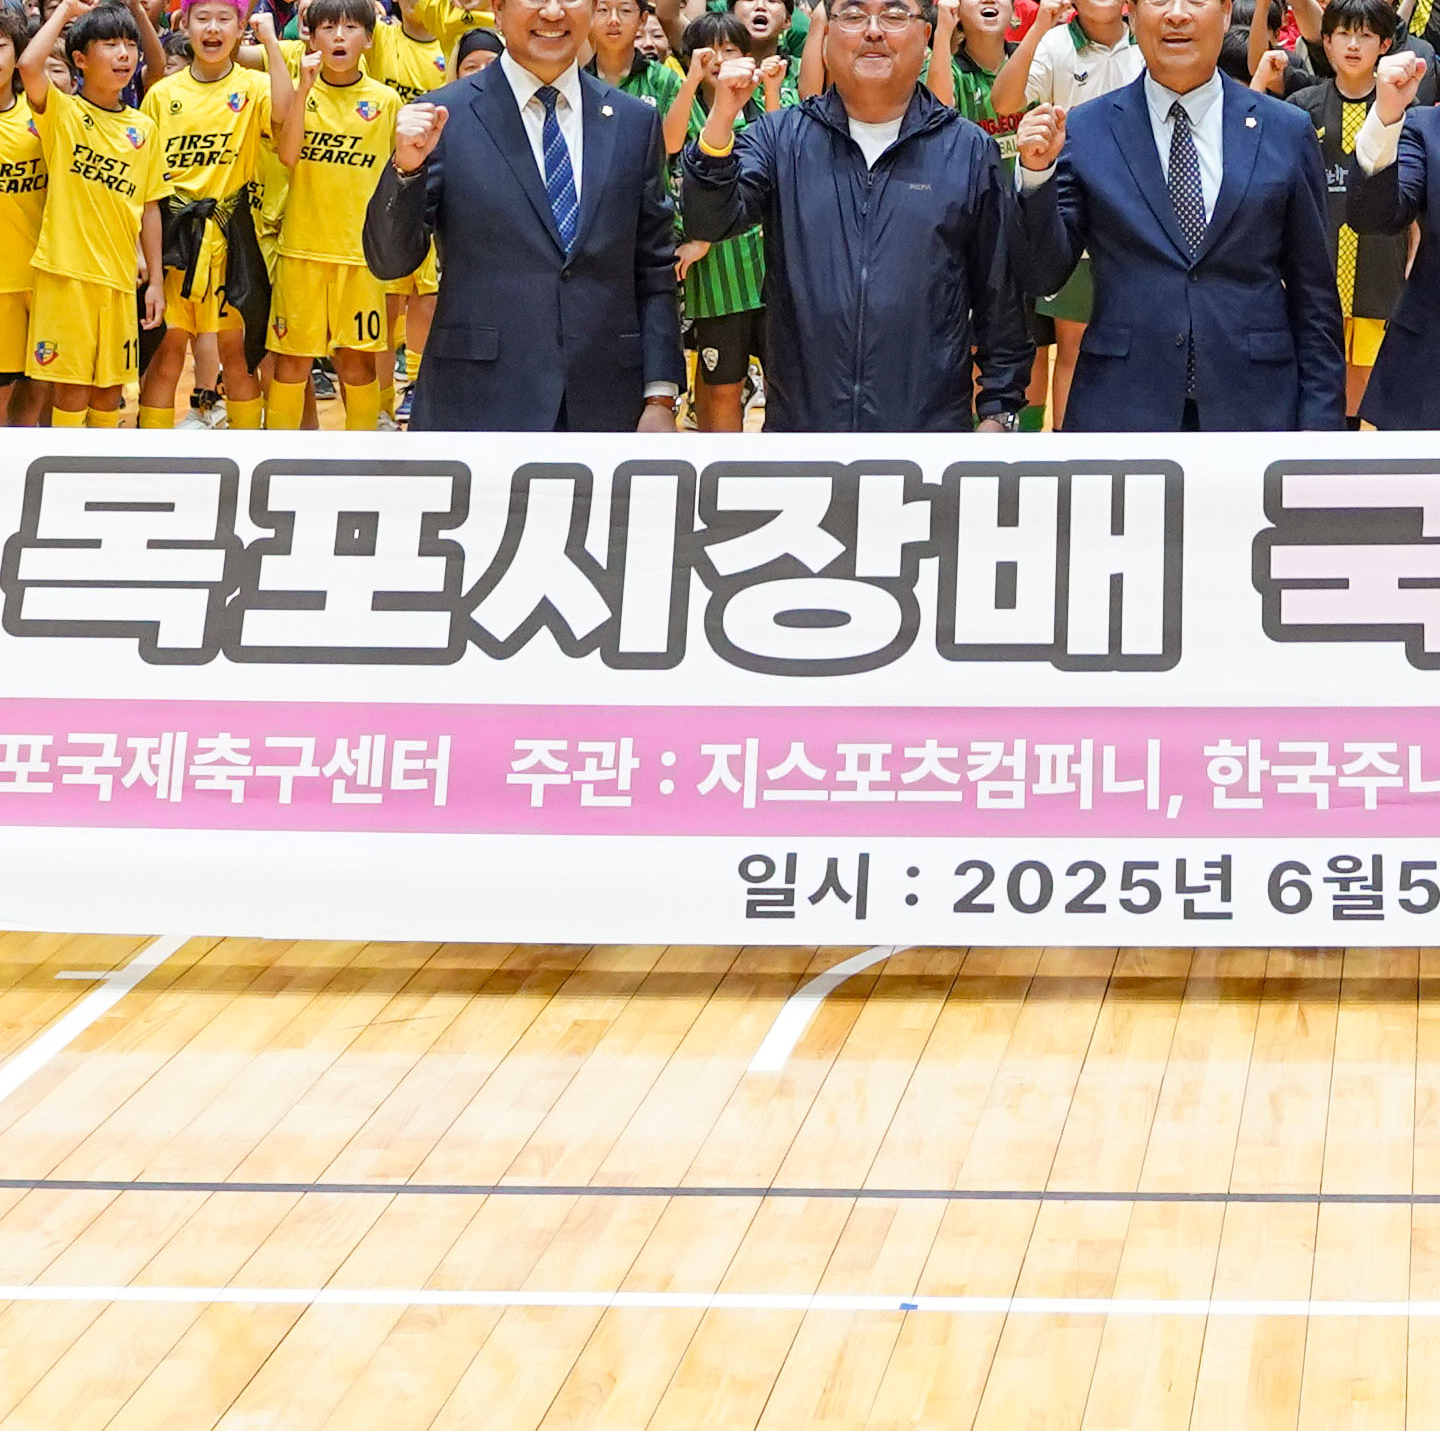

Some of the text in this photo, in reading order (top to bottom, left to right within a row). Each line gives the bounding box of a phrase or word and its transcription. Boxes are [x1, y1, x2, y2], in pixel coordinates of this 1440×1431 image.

[165, 132, 234, 154] FIRST
[303, 130, 363, 150] FIRST
[71, 144, 132, 176] FIRST
[166, 150, 239, 169] SEARC
[300, 147, 377, 170] SEARCH
[68, 160, 137, 198] SEARCH
[353, 310, 381, 341] 10
[0, 456, 1184, 676] 목포시장배
[505, 736, 640, 809] 주관
[696, 737, 1184, 820] 지스포츠컴퍼니,
[738, 852, 872, 921] 일시
[952, 853, 1236, 922] 2025년
